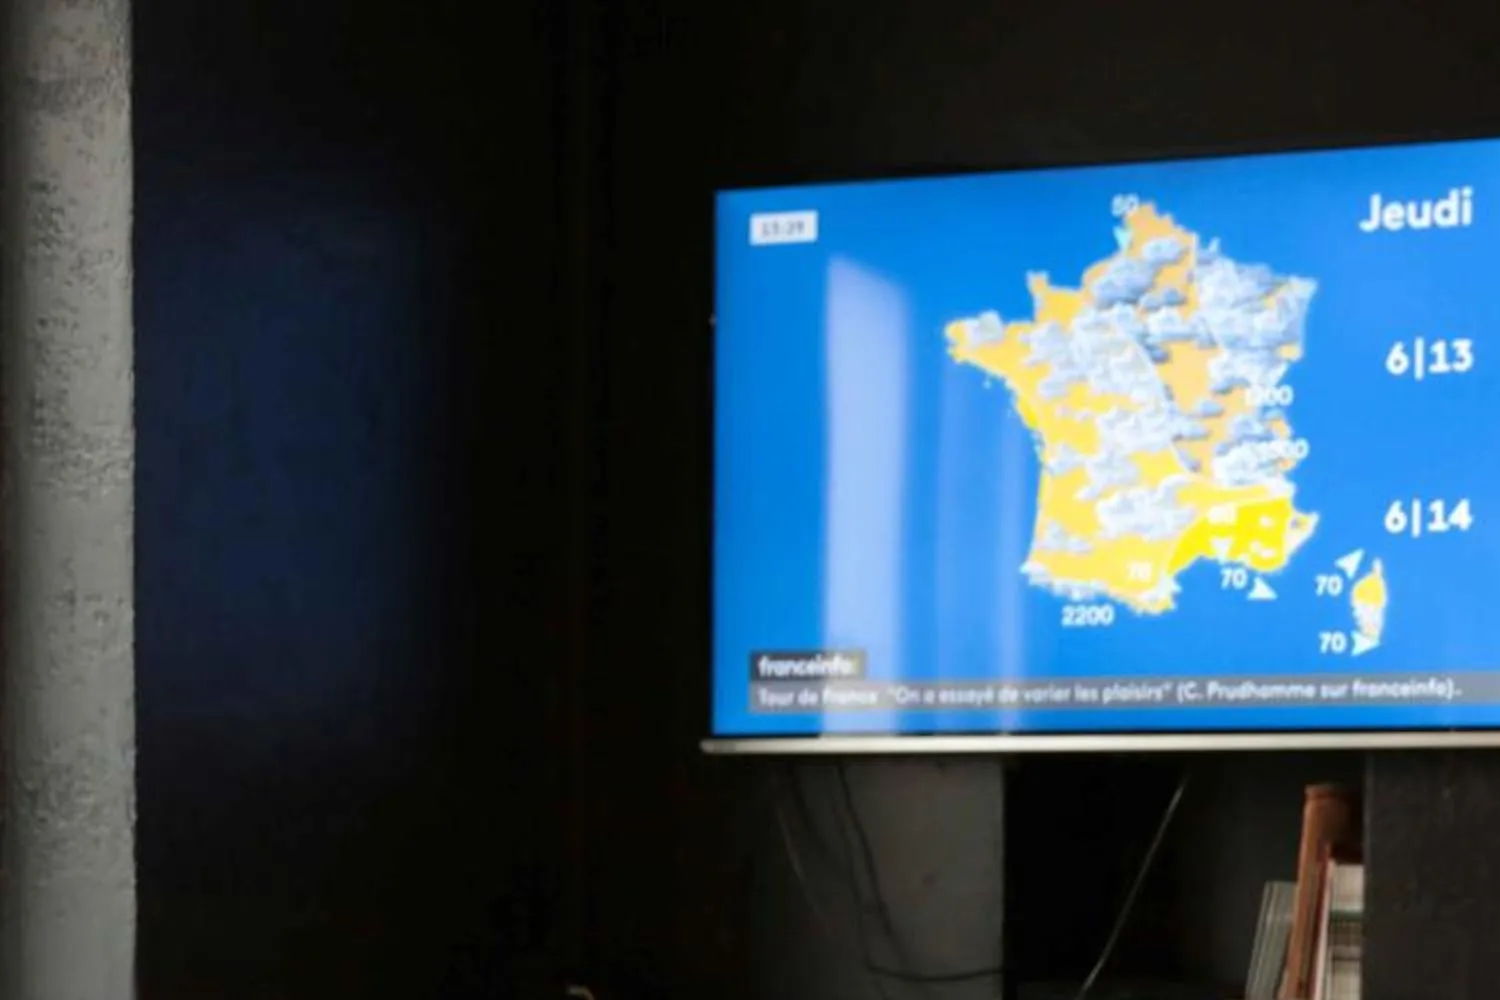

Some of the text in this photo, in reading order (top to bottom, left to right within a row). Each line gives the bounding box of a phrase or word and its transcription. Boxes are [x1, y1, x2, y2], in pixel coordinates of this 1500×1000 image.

[1360, 186, 1473, 232] Jeudi
[1221, 567, 1248, 589] 70
[1315, 574, 1342, 596] 70
[1061, 604, 1115, 627] 2200
[1319, 632, 1346, 653] 70
[1320, 683, 1348, 699] sur
